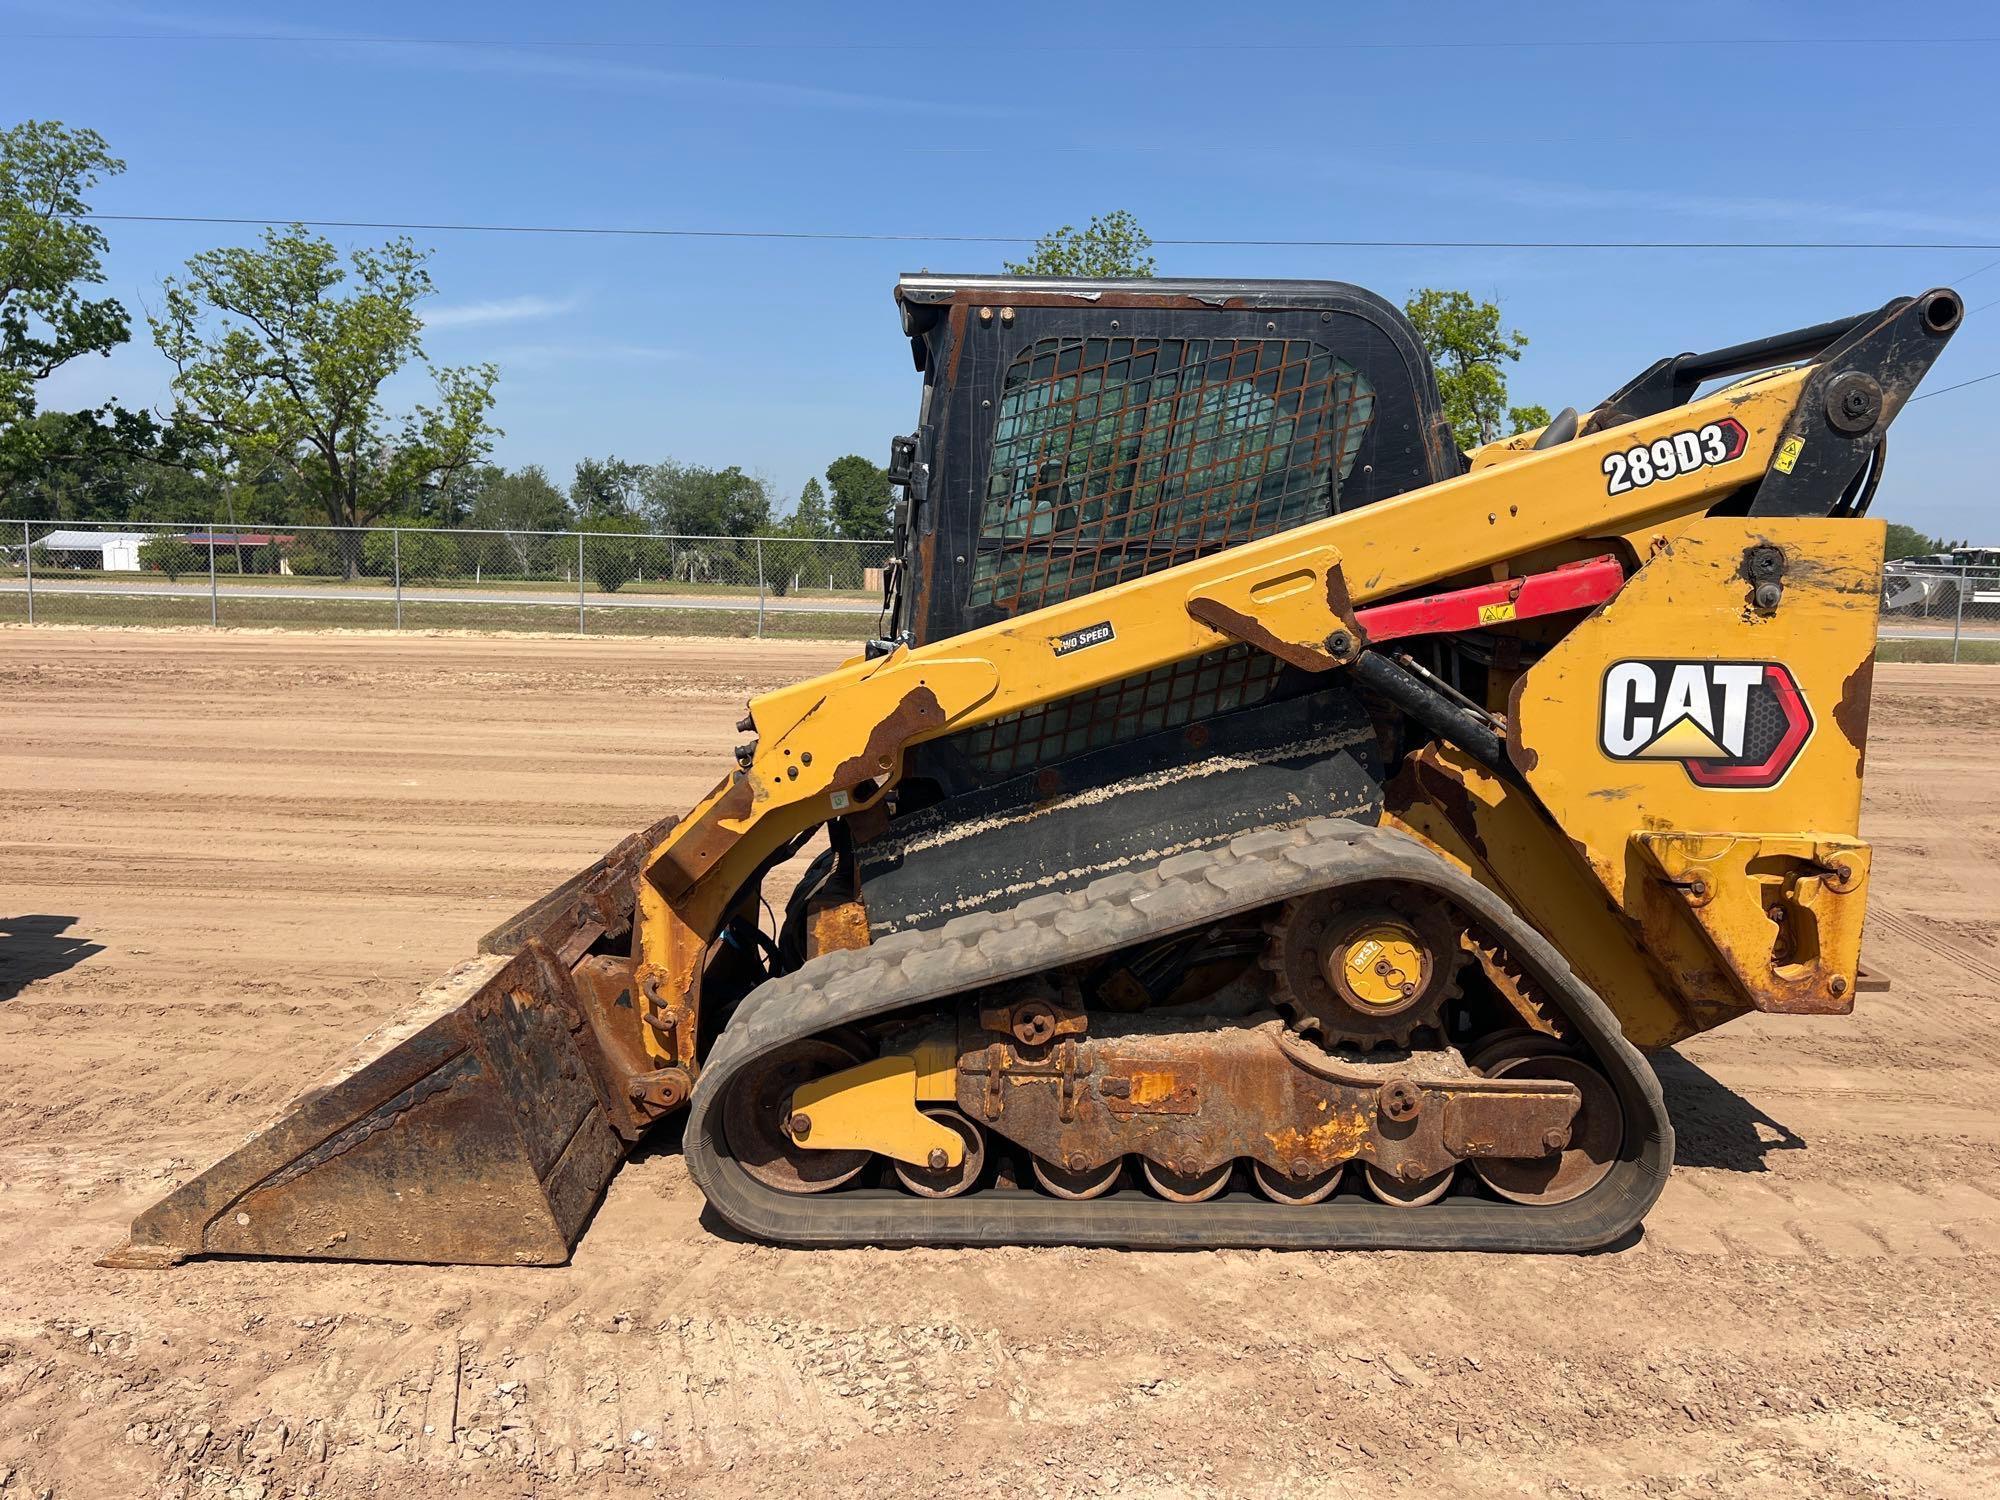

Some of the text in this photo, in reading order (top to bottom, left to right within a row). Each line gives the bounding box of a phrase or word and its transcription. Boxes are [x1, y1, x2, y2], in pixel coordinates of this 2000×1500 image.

[1603, 424, 1727, 494] 289D3
[1079, 627, 1109, 645] SPEED
[1604, 662, 1764, 758] CAT
